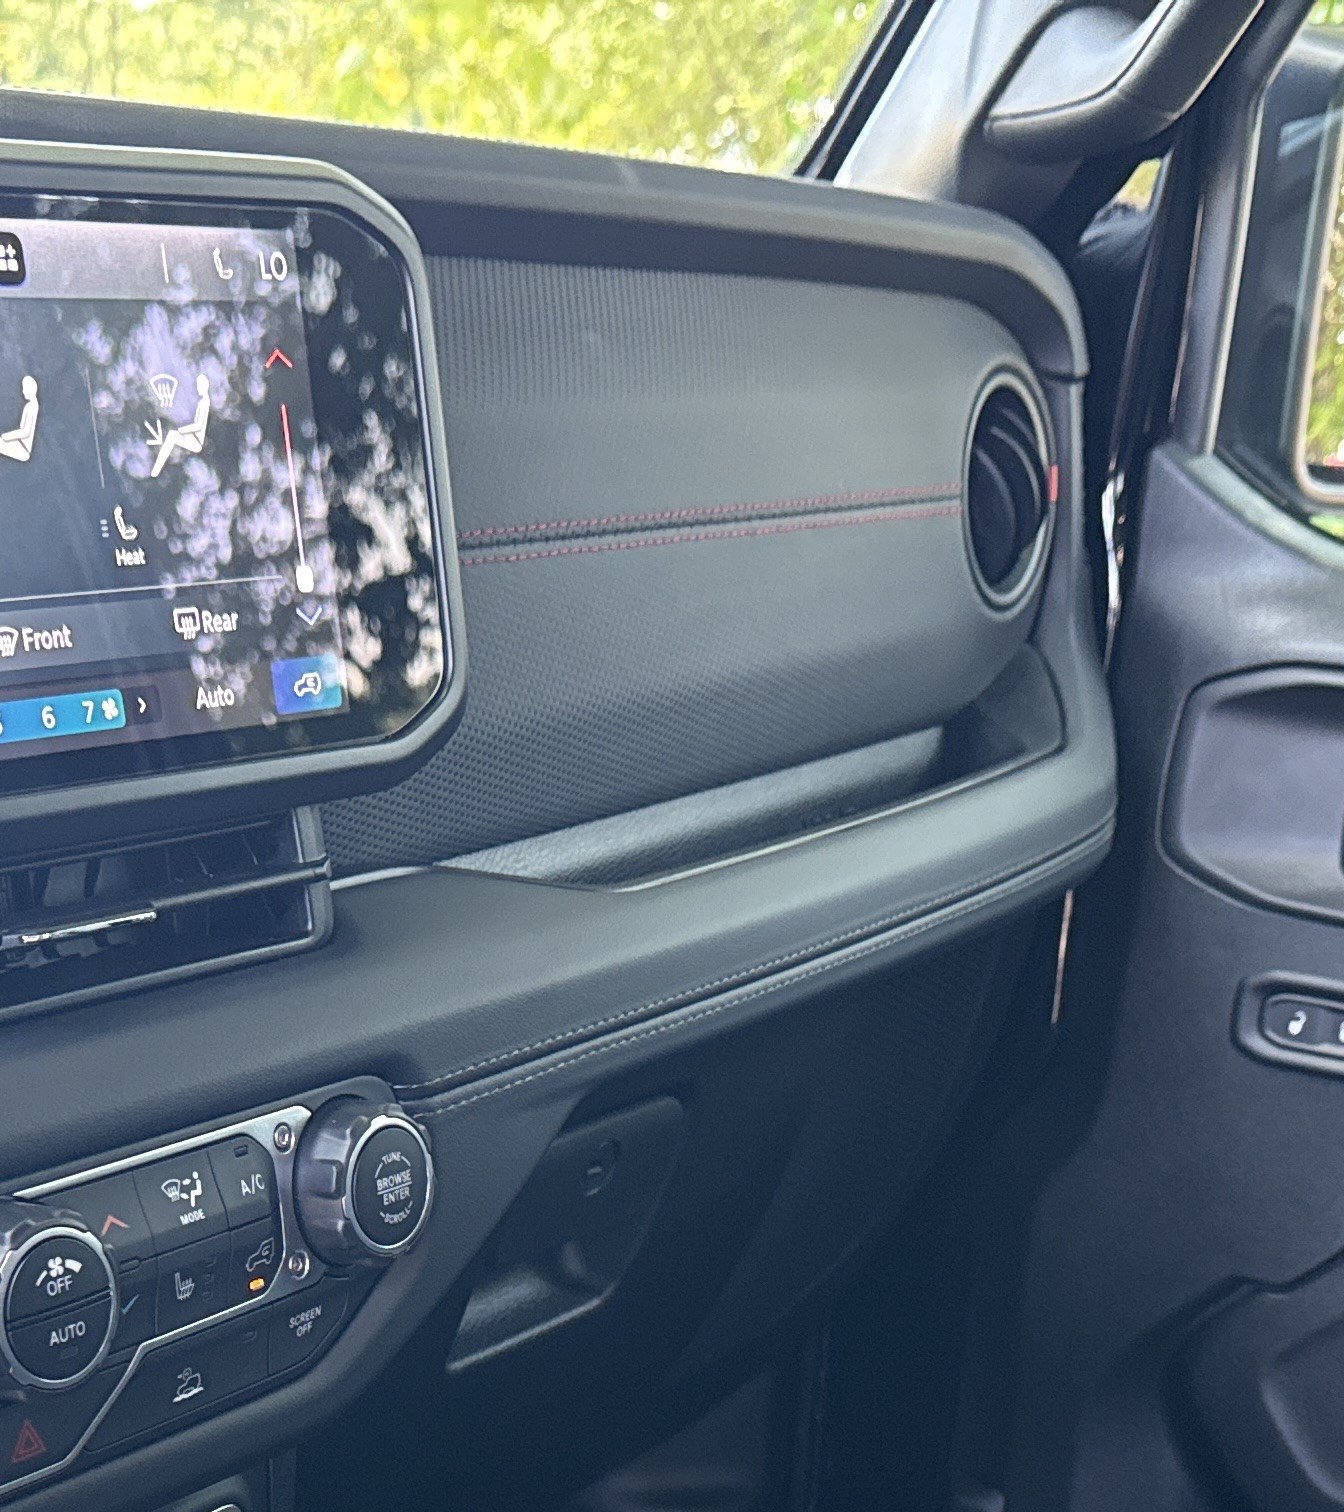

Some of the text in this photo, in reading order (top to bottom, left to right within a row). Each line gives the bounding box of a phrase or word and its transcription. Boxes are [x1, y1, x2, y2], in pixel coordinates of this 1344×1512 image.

[259, 251, 287, 281] LO
[115, 547, 146, 567] Heat
[201, 608, 238, 633] Rear
[22, 624, 73, 651] Front
[195, 685, 236, 710] Auto
[41, 705, 56, 728] 6
[81, 700, 94, 724] 7
[382, 1153, 403, 1165] TUNE
[240, 1173, 266, 1197] A/C
[377, 1169, 412, 1192] BROWSE
[383, 1186, 412, 1205] ENTER
[179, 1208, 206, 1225] MODE
[383, 1205, 413, 1225] SCROLL
[46, 1274, 74, 1297] OFF
[289, 1304, 322, 1328] SCREEN
[49, 1320, 87, 1346] AUTO
[296, 1319, 314, 1337] OFF
